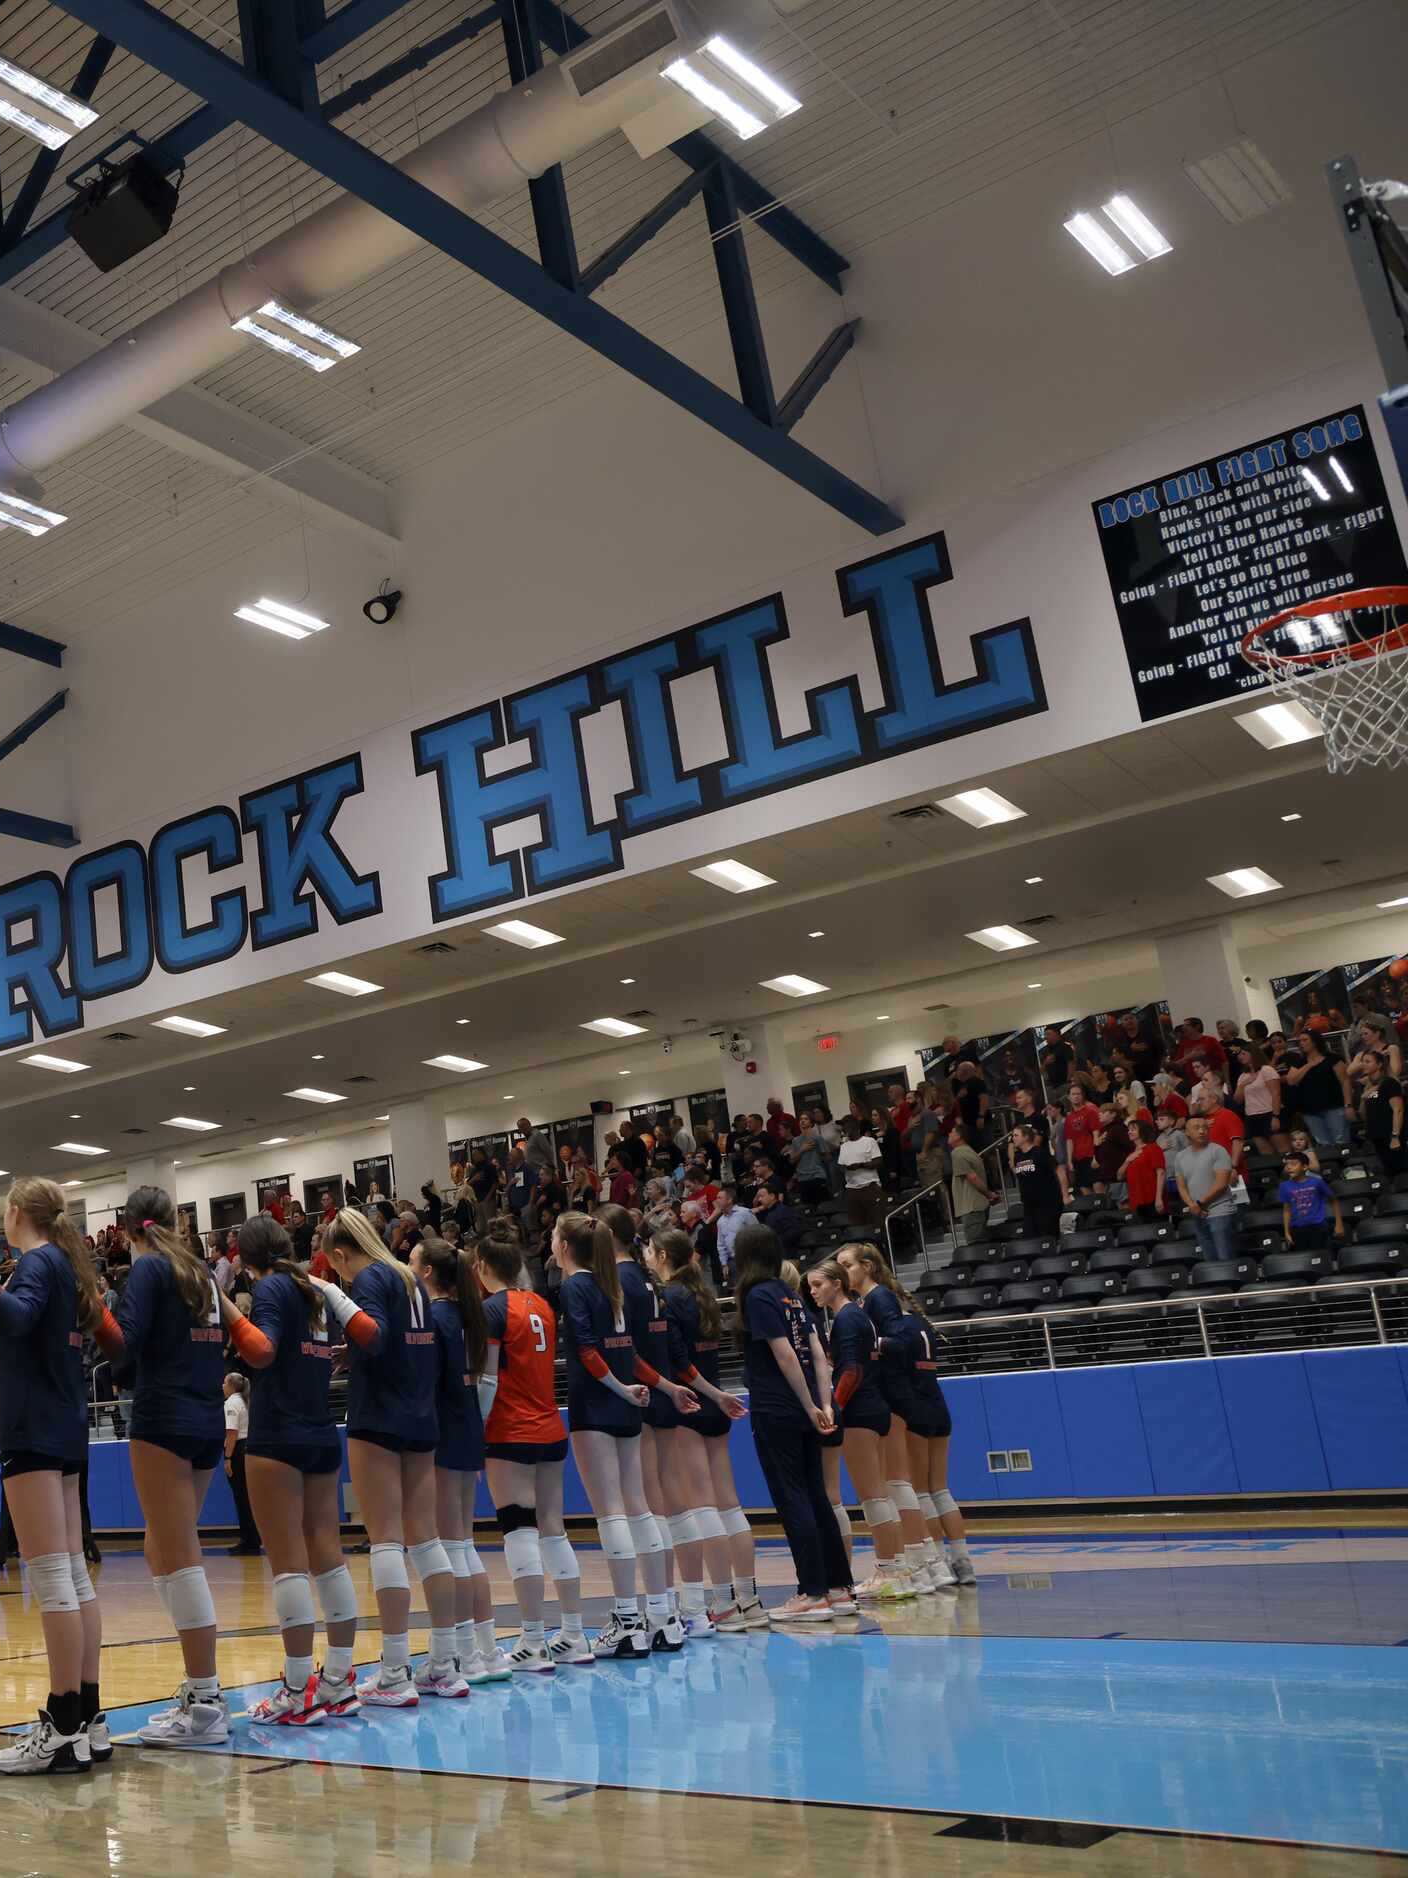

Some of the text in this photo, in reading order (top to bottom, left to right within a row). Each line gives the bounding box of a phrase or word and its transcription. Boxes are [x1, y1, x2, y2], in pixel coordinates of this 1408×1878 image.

[1098, 414, 1363, 529] ROCK HILL FIGHT SONG
[1195, 488, 1232, 511] Black
[1235, 476, 1260, 497] and
[1263, 464, 1305, 486] White
[1160, 479, 1313, 540] Hawks fight with Pride
[1166, 497, 1312, 554] Victory is on our side
[1119, 506, 1385, 604] Going FIGHT ROCK FIGHT ROCK FIGHT
[1183, 547, 1209, 567] Yell
[1225, 533, 1257, 552] Blue
[1259, 517, 1304, 541] Hawks
[1194, 551, 1308, 597] Let's go Big Blue
[1200, 567, 1310, 612] Our Spirit's true
[1168, 614, 1220, 640] Another
[1223, 605, 1248, 622] win
[1251, 599, 1270, 614] we
[1273, 587, 1301, 607] will
[1304, 571, 1354, 598] pursue
[1202, 627, 1228, 646] Yell
[1137, 662, 1175, 684] Going
[1186, 646, 1222, 669] FIGHT
[1208, 661, 1232, 679] GO!
[411, 531, 1048, 924] HILL
[529, 1313, 547, 1352] 9
